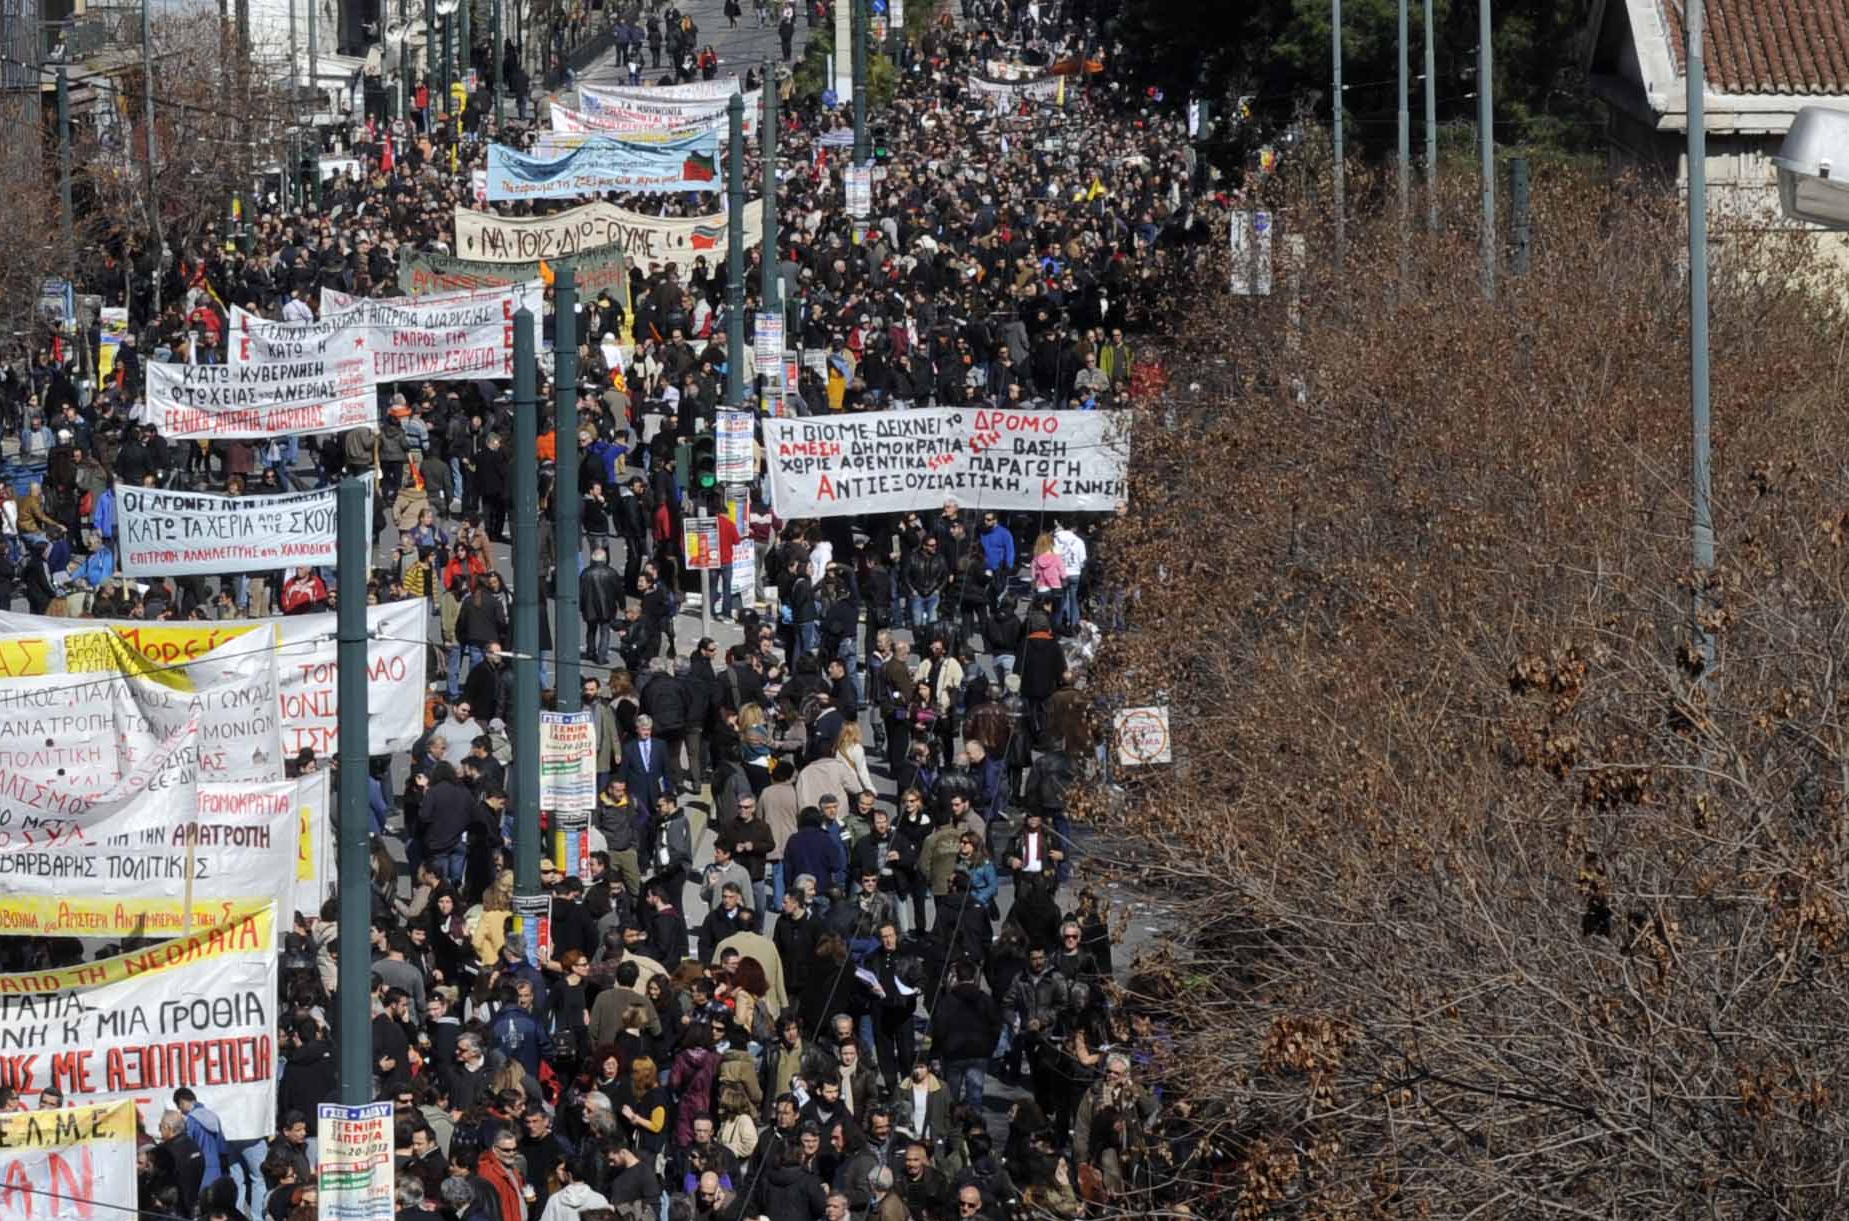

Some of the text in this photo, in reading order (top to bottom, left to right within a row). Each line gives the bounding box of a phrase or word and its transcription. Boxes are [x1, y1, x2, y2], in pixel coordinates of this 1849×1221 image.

[781, 425, 794, 442] Η
[876, 416, 941, 438] ΔΕΙΧΝΕΙ
[975, 410, 1059, 433] ΔΡΟΜΟ
[779, 440, 841, 457] ΑΜΕΣΗ
[851, 437, 964, 456] ΔΗΜΟΚΡΑΤΙΑ
[1013, 437, 1067, 457] ΒΑΣΗ
[840, 454, 927, 471] ΑΦΕΝΤΙΚΑ
[1042, 479, 1126, 500] ΚΙΝΗΣΗ
[123, 492, 144, 512] ΟΙ
[182, 516, 201, 538] ΤΑ
[207, 513, 254, 539] ΧΕΡΙΑ
[0, 714, 117, 737] ΑΝΑΤΡΟΠΗ
[0, 975, 61, 993] ΑΠΟ
[70, 967, 107, 986] ΤΗ
[96, 1005, 151, 1039] ΜΙΑ
[159, 991, 266, 1035] ΓΡΟΘΙΑ
[51, 1049, 97, 1094] ΜΕ
